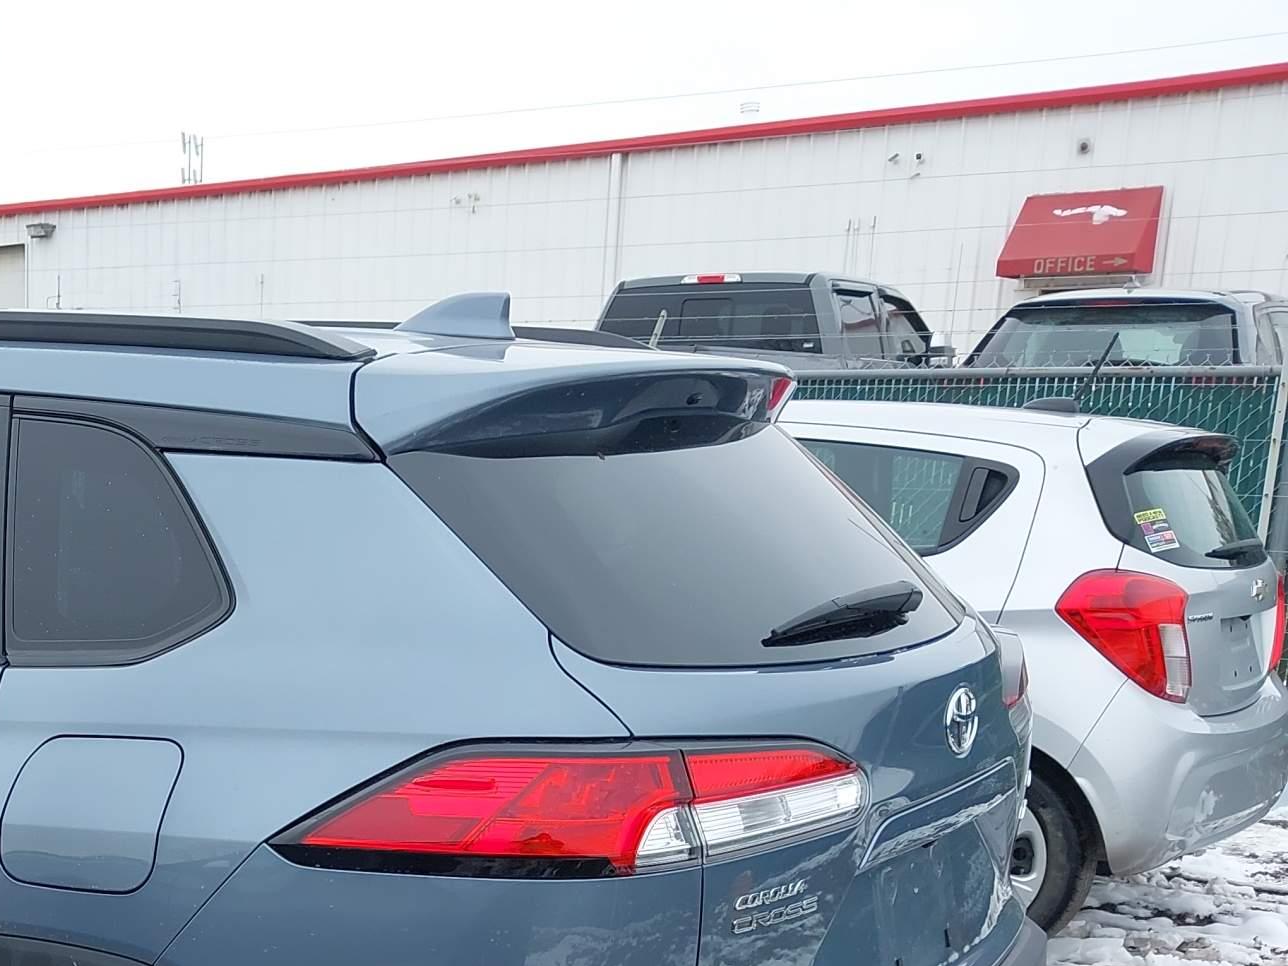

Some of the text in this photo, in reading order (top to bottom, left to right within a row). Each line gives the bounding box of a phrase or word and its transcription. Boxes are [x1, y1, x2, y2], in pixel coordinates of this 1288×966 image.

[1033, 255, 1096, 274] OFFICE
[734, 879, 808, 911] COROLLA
[732, 896, 818, 934] CROSS
